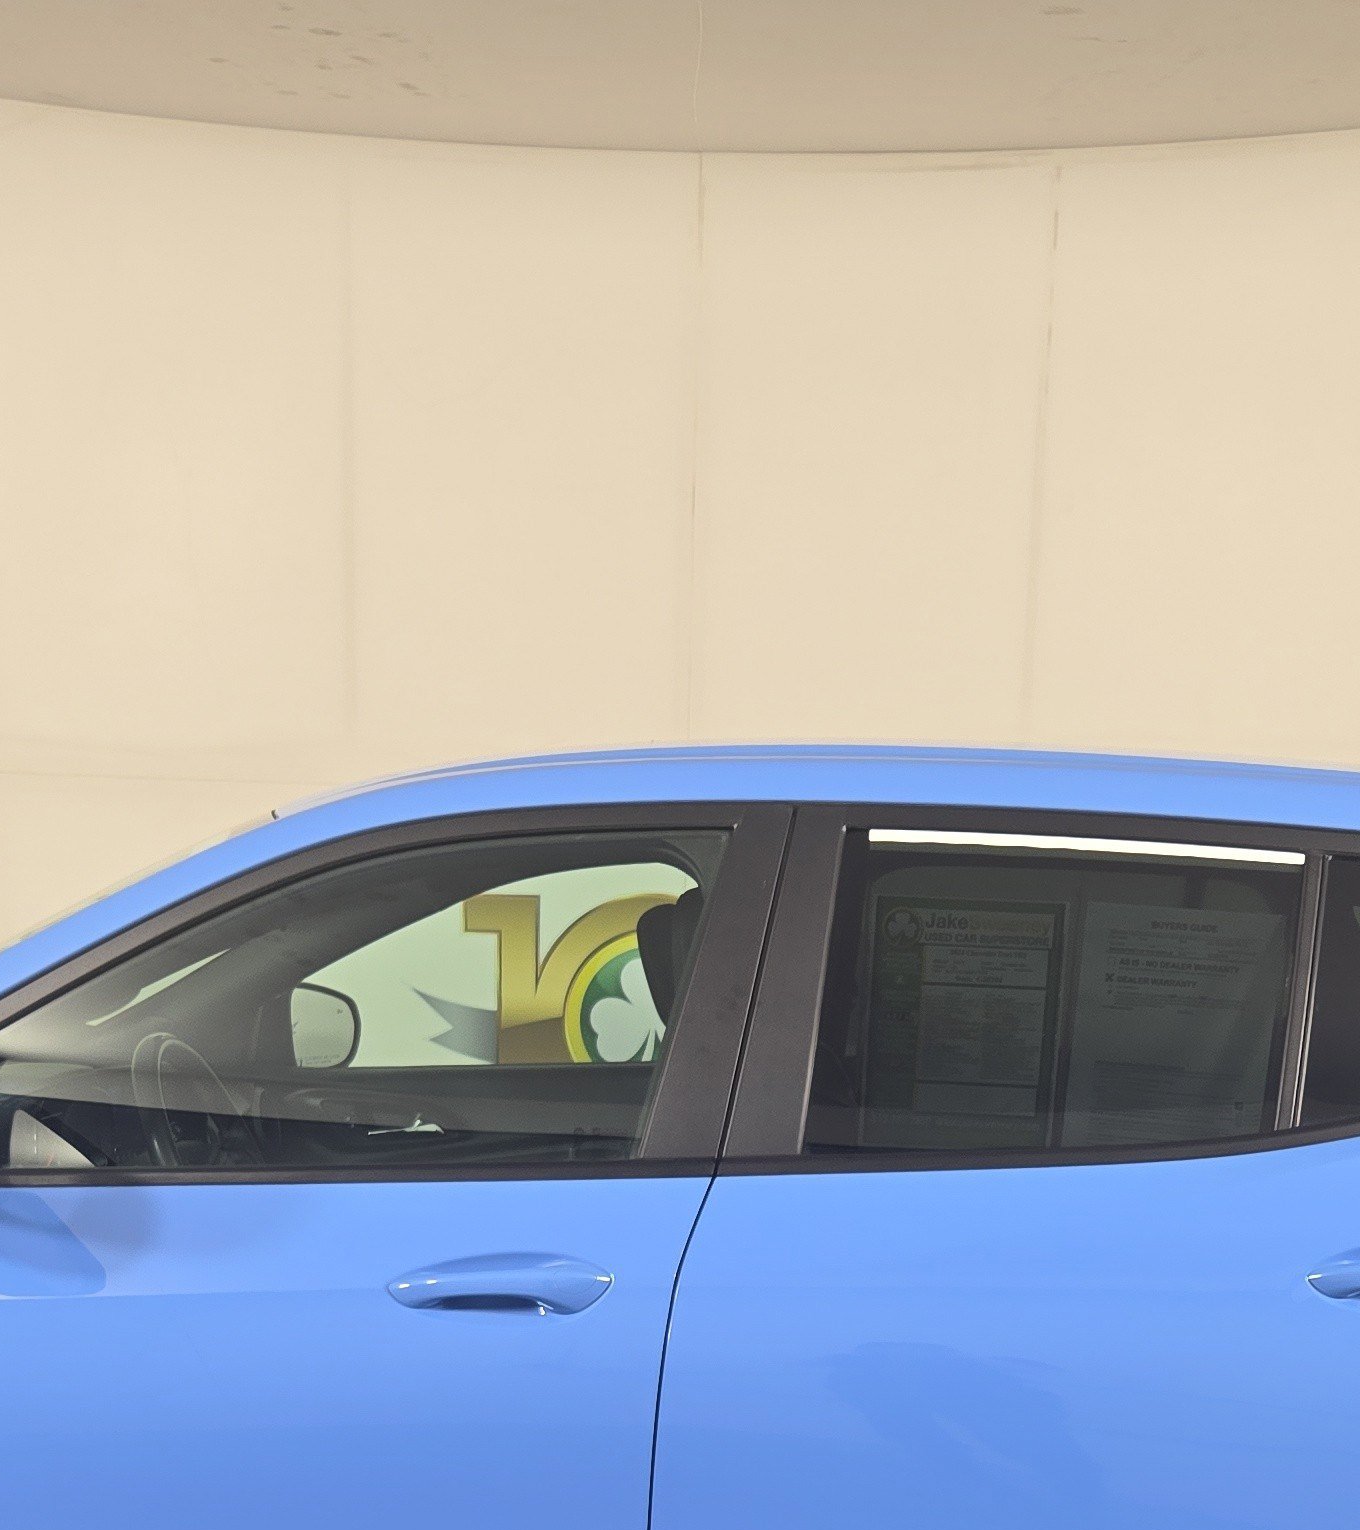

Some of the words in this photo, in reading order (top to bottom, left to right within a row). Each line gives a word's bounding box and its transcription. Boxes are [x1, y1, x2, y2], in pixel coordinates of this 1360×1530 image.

[925, 912, 969, 930] Jake
[1150, 920, 1188, 932] BUYERS
[1189, 923, 1219, 934] GUIDE
[924, 932, 953, 943] USED
[954, 934, 978, 944] CAR
